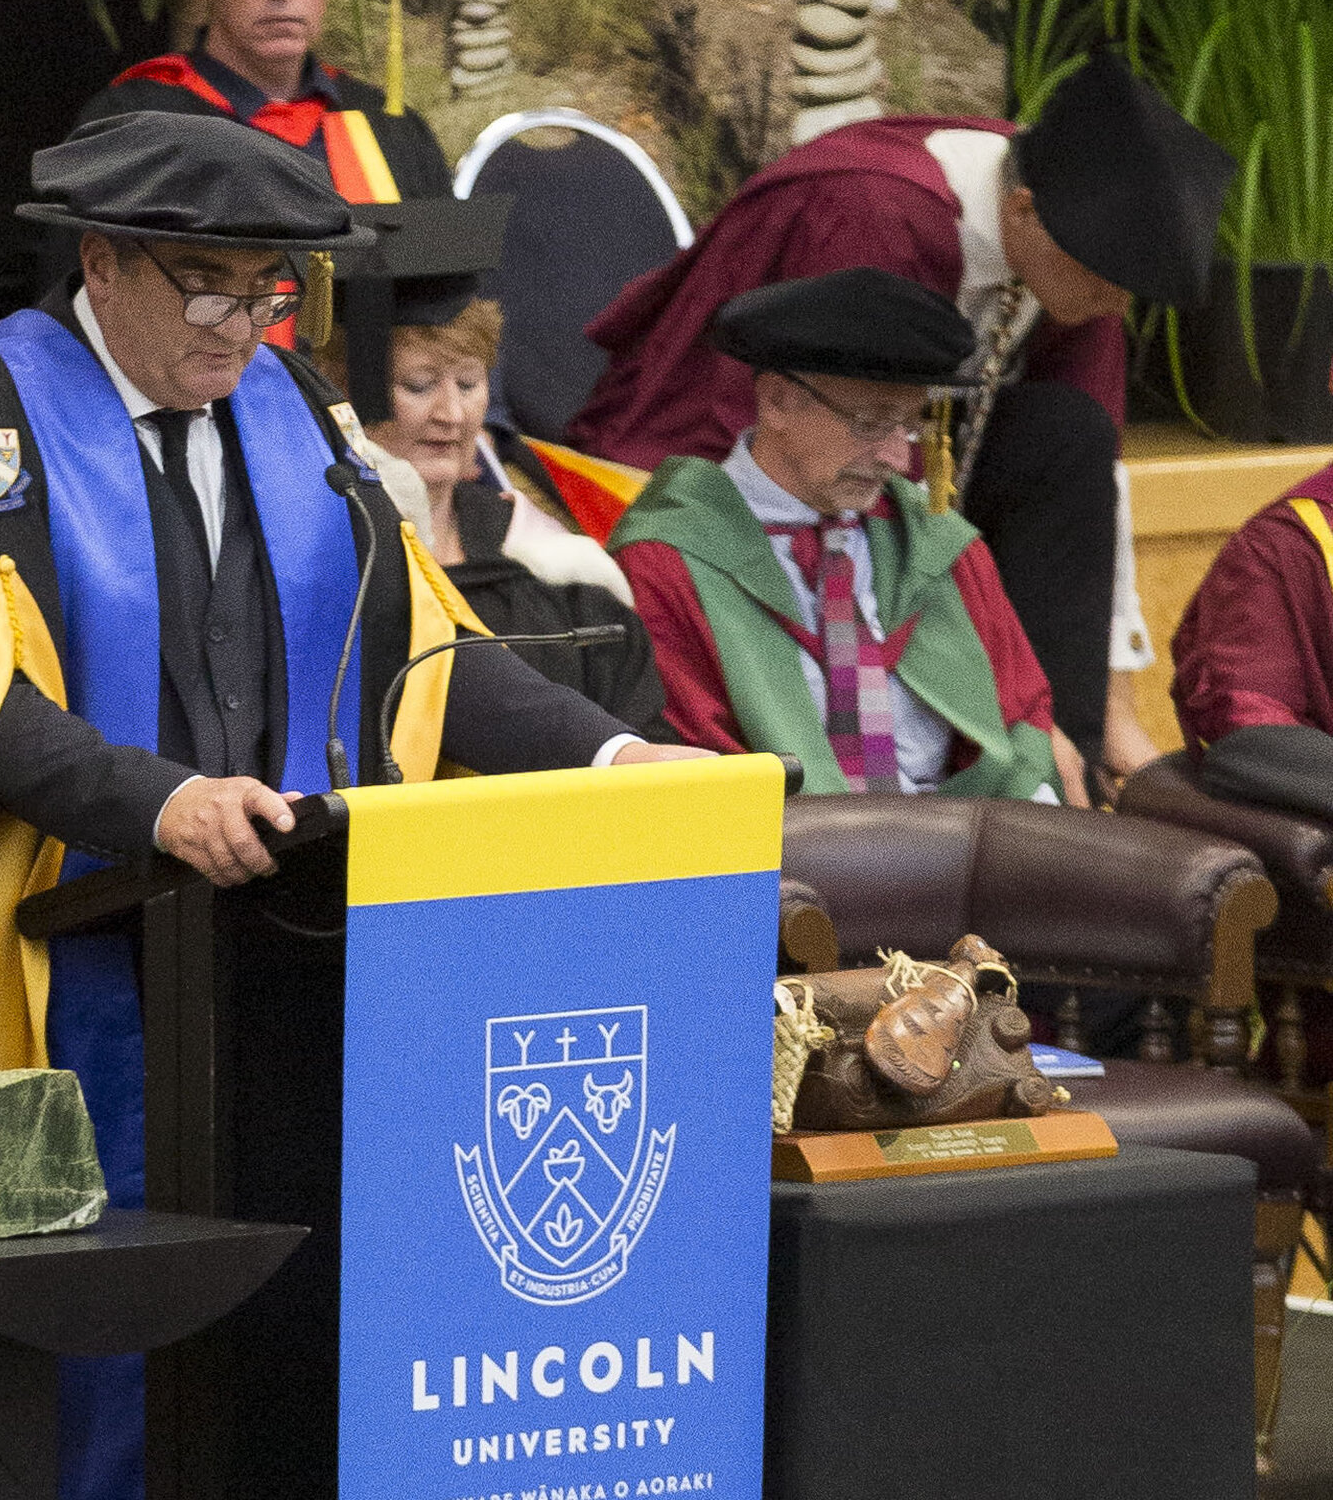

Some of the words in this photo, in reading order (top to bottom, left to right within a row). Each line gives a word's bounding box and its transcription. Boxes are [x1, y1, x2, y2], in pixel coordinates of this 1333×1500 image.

[467, 1174, 500, 1243] SCIENTIA
[627, 1151, 665, 1232] PROBITATE
[412, 1332, 715, 1411] LINCOLN
[453, 1417, 675, 1466] UNIVERSITY
[613, 1481, 629, 1498] O
[636, 1472, 713, 1496] AORAKI
